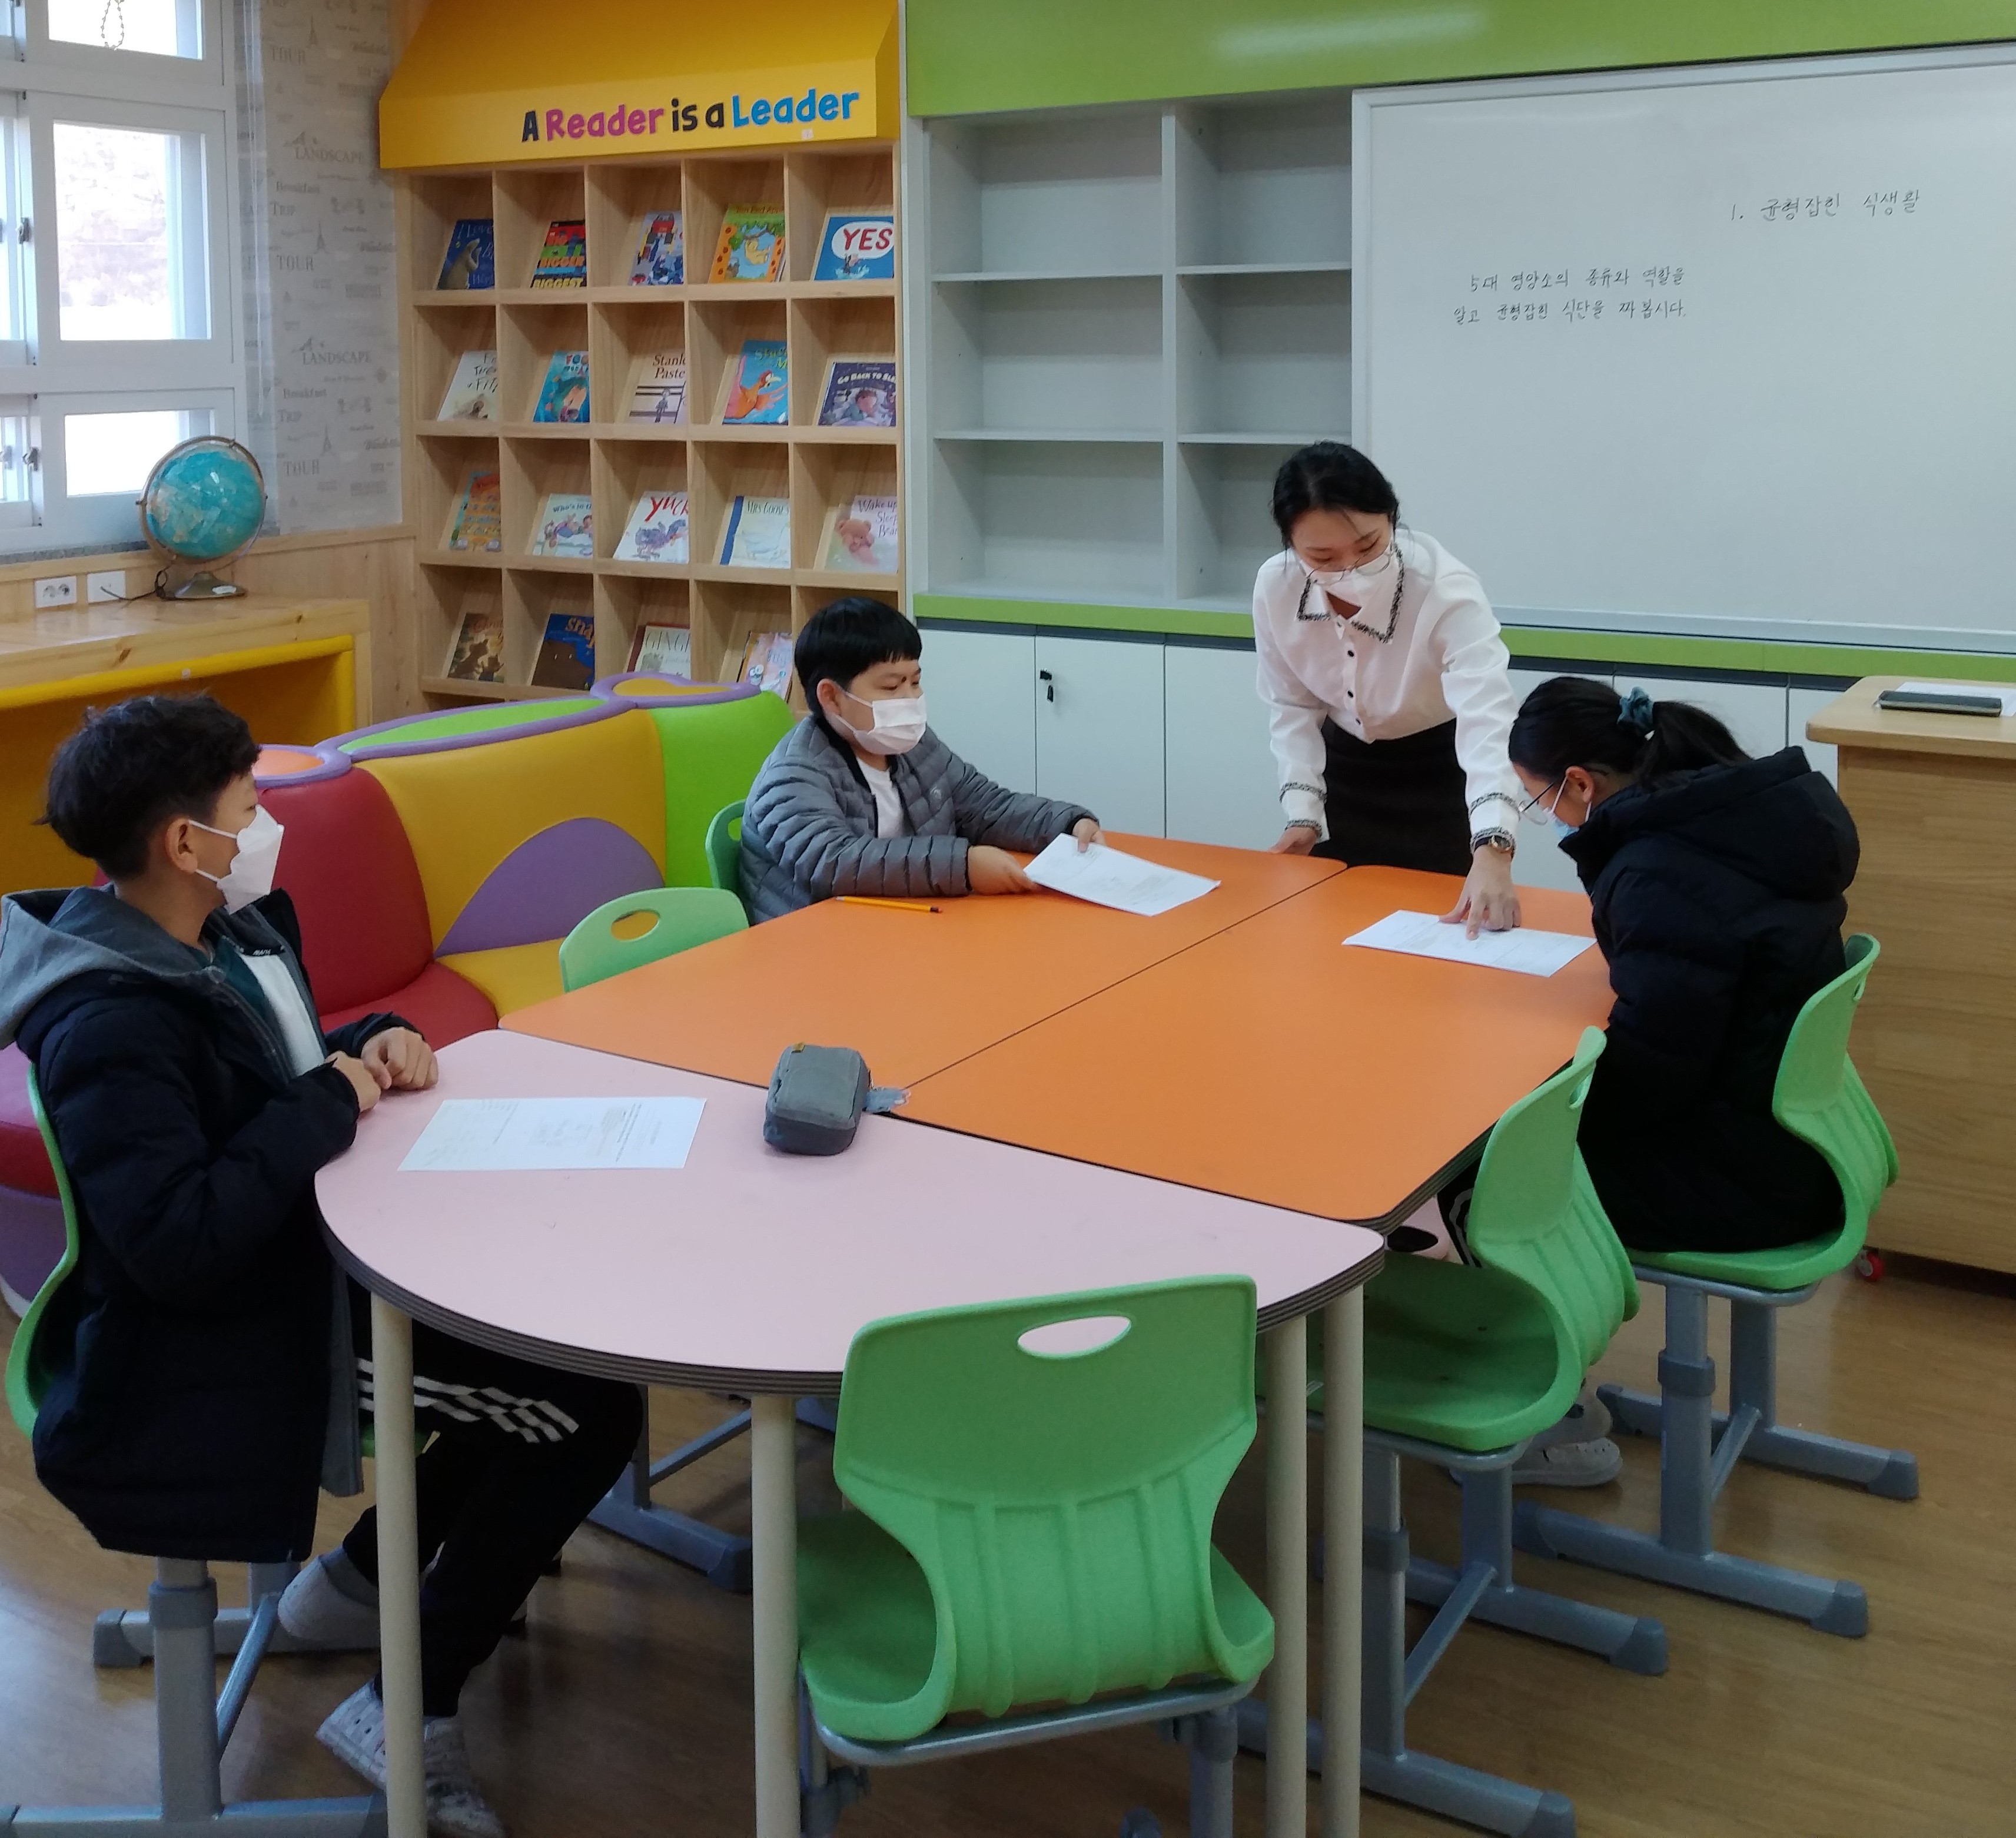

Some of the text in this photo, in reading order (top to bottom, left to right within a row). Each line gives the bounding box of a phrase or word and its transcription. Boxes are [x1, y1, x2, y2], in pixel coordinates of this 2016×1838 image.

[522, 88, 859, 142] A Reader is a Leader
[1760, 193, 1840, 222] 균형잡힌
[1863, 189, 1919, 218] 식생활
[843, 228, 893, 250] YES
[276, 254, 315, 272] TOUR
[1471, 274, 1498, 293] 5대
[1586, 268, 1630, 288] 종류와
[1562, 298, 1604, 323] 식단을
[303, 351, 371, 365] LANDSCAPE
